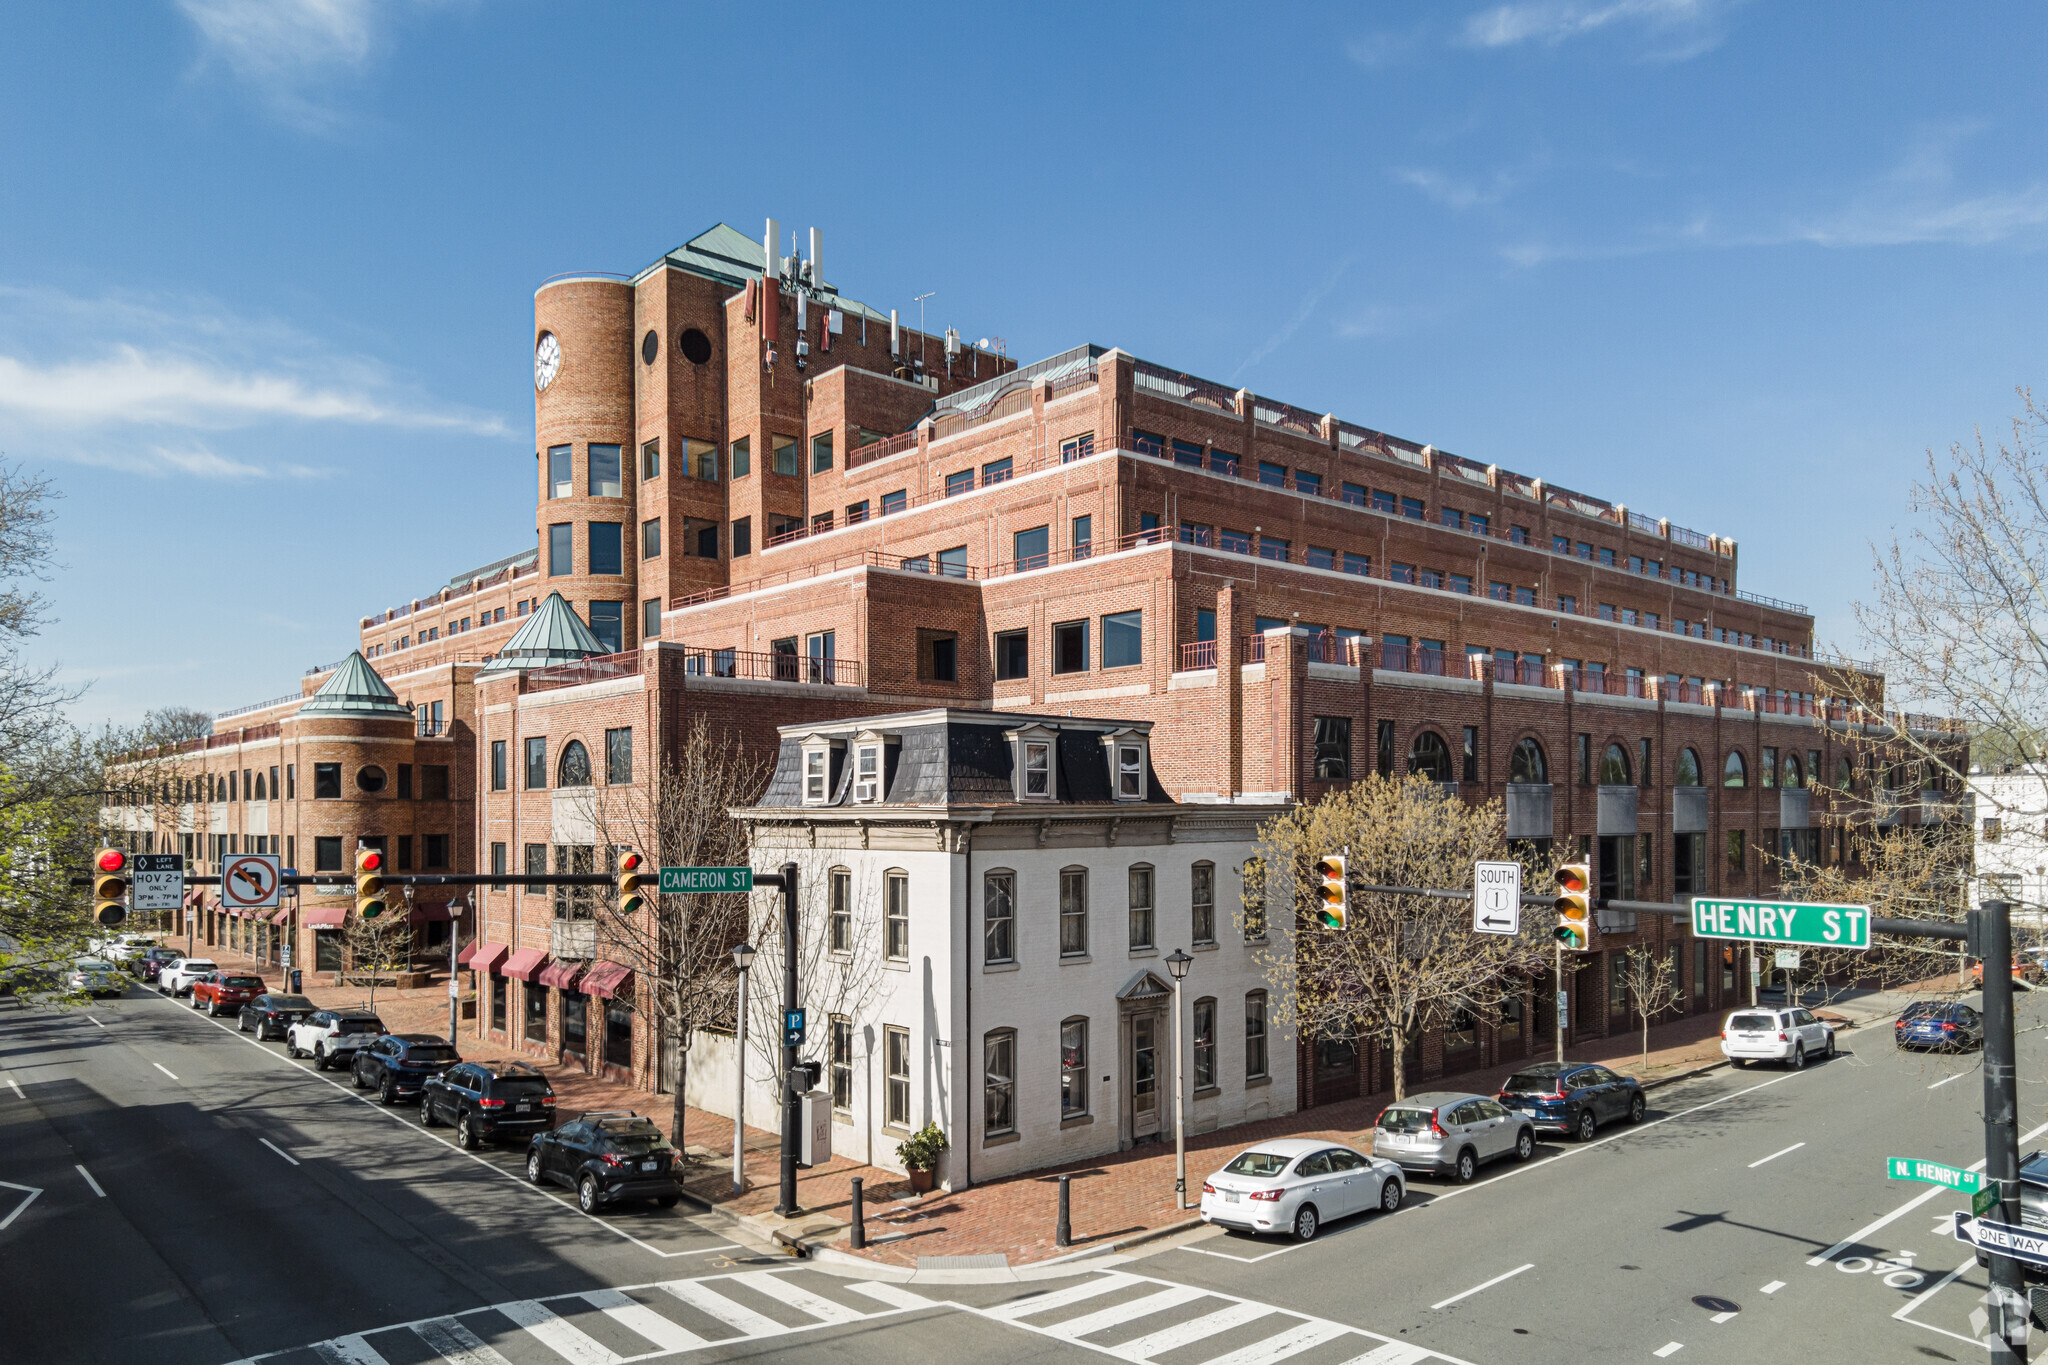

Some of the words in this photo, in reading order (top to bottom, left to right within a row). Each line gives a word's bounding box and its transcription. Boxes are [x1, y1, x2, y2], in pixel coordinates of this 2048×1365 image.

[136, 874, 161, 883] HOV
[165, 873, 180, 883] 2+
[663, 872, 726, 888] CAMERON
[732, 871, 747, 887] ST
[1480, 869, 1515, 884] SOUTH
[1494, 891, 1499, 908] 1
[1699, 904, 1798, 937] HENRY
[1822, 911, 1863, 942] ST
[791, 1014, 800, 1028] P
[1896, 1161, 1911, 1176] N.
[1916, 1162, 1961, 1186] HENRY
[1963, 1173, 1975, 1183] ST
[1980, 1228, 2006, 1245] ONE
[2012, 1235, 2044, 1253] WAY
